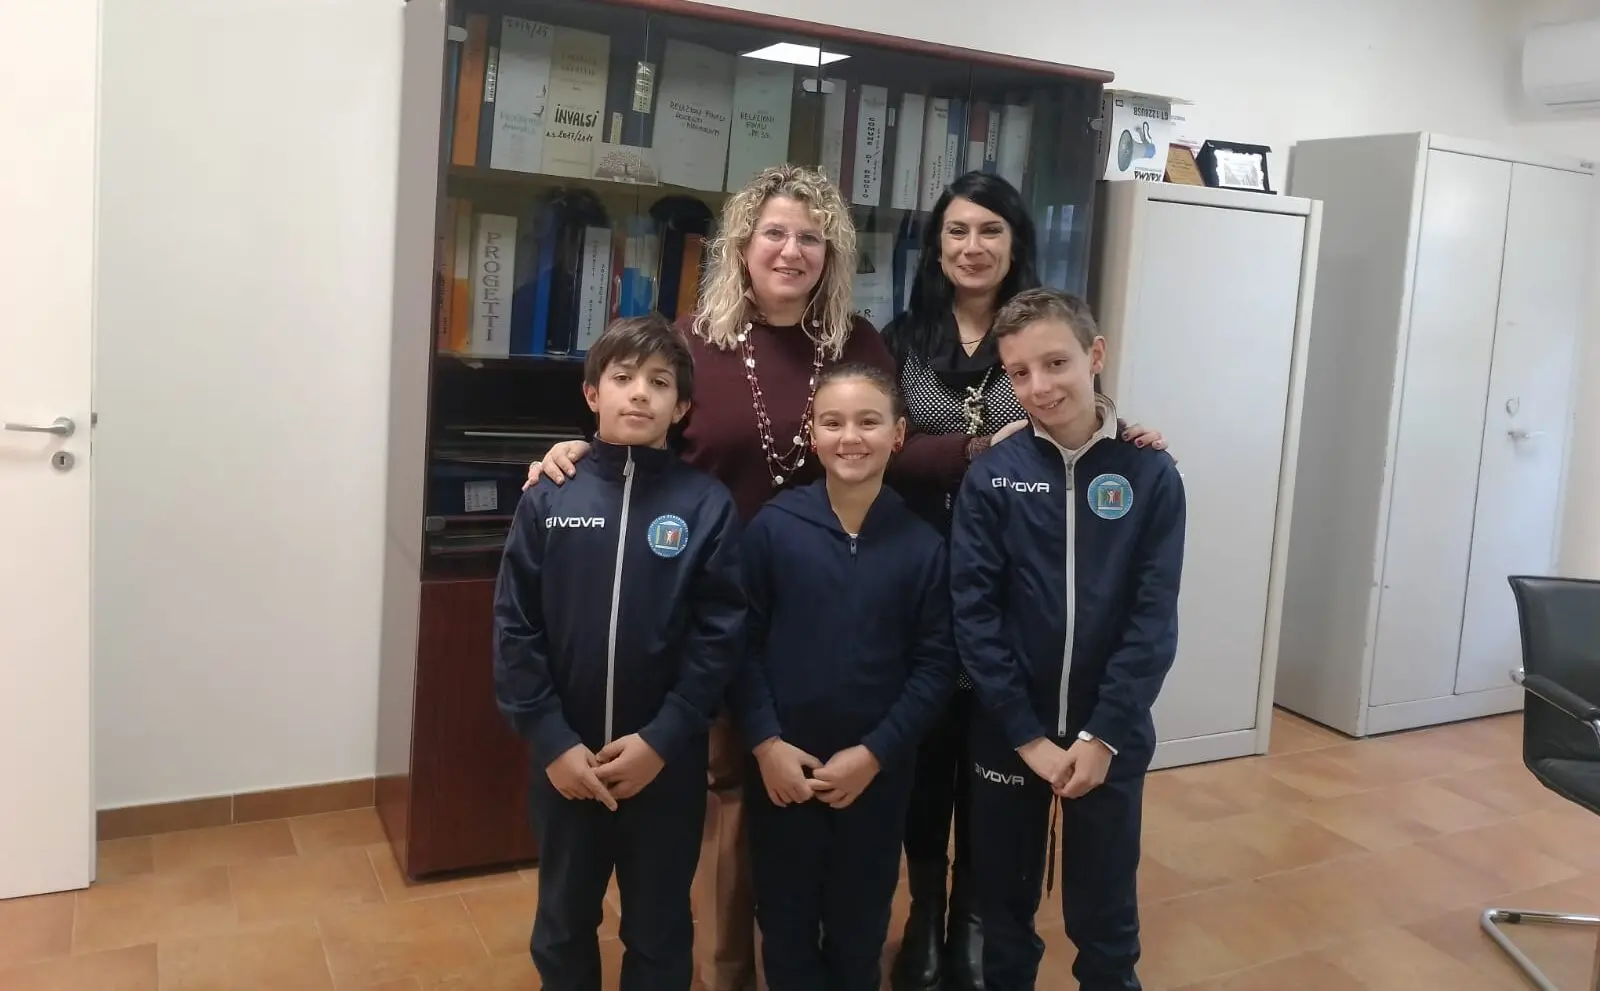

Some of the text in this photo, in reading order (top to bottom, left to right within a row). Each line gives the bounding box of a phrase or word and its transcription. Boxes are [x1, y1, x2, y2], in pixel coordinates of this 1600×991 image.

[740, 111, 775, 123] RELAZIONI
[481, 231, 500, 342] PROGETTI
[991, 476, 1050, 493] GIVOVA
[545, 516, 605, 529] GIVOVA
[975, 762, 1025, 786] VOVA
